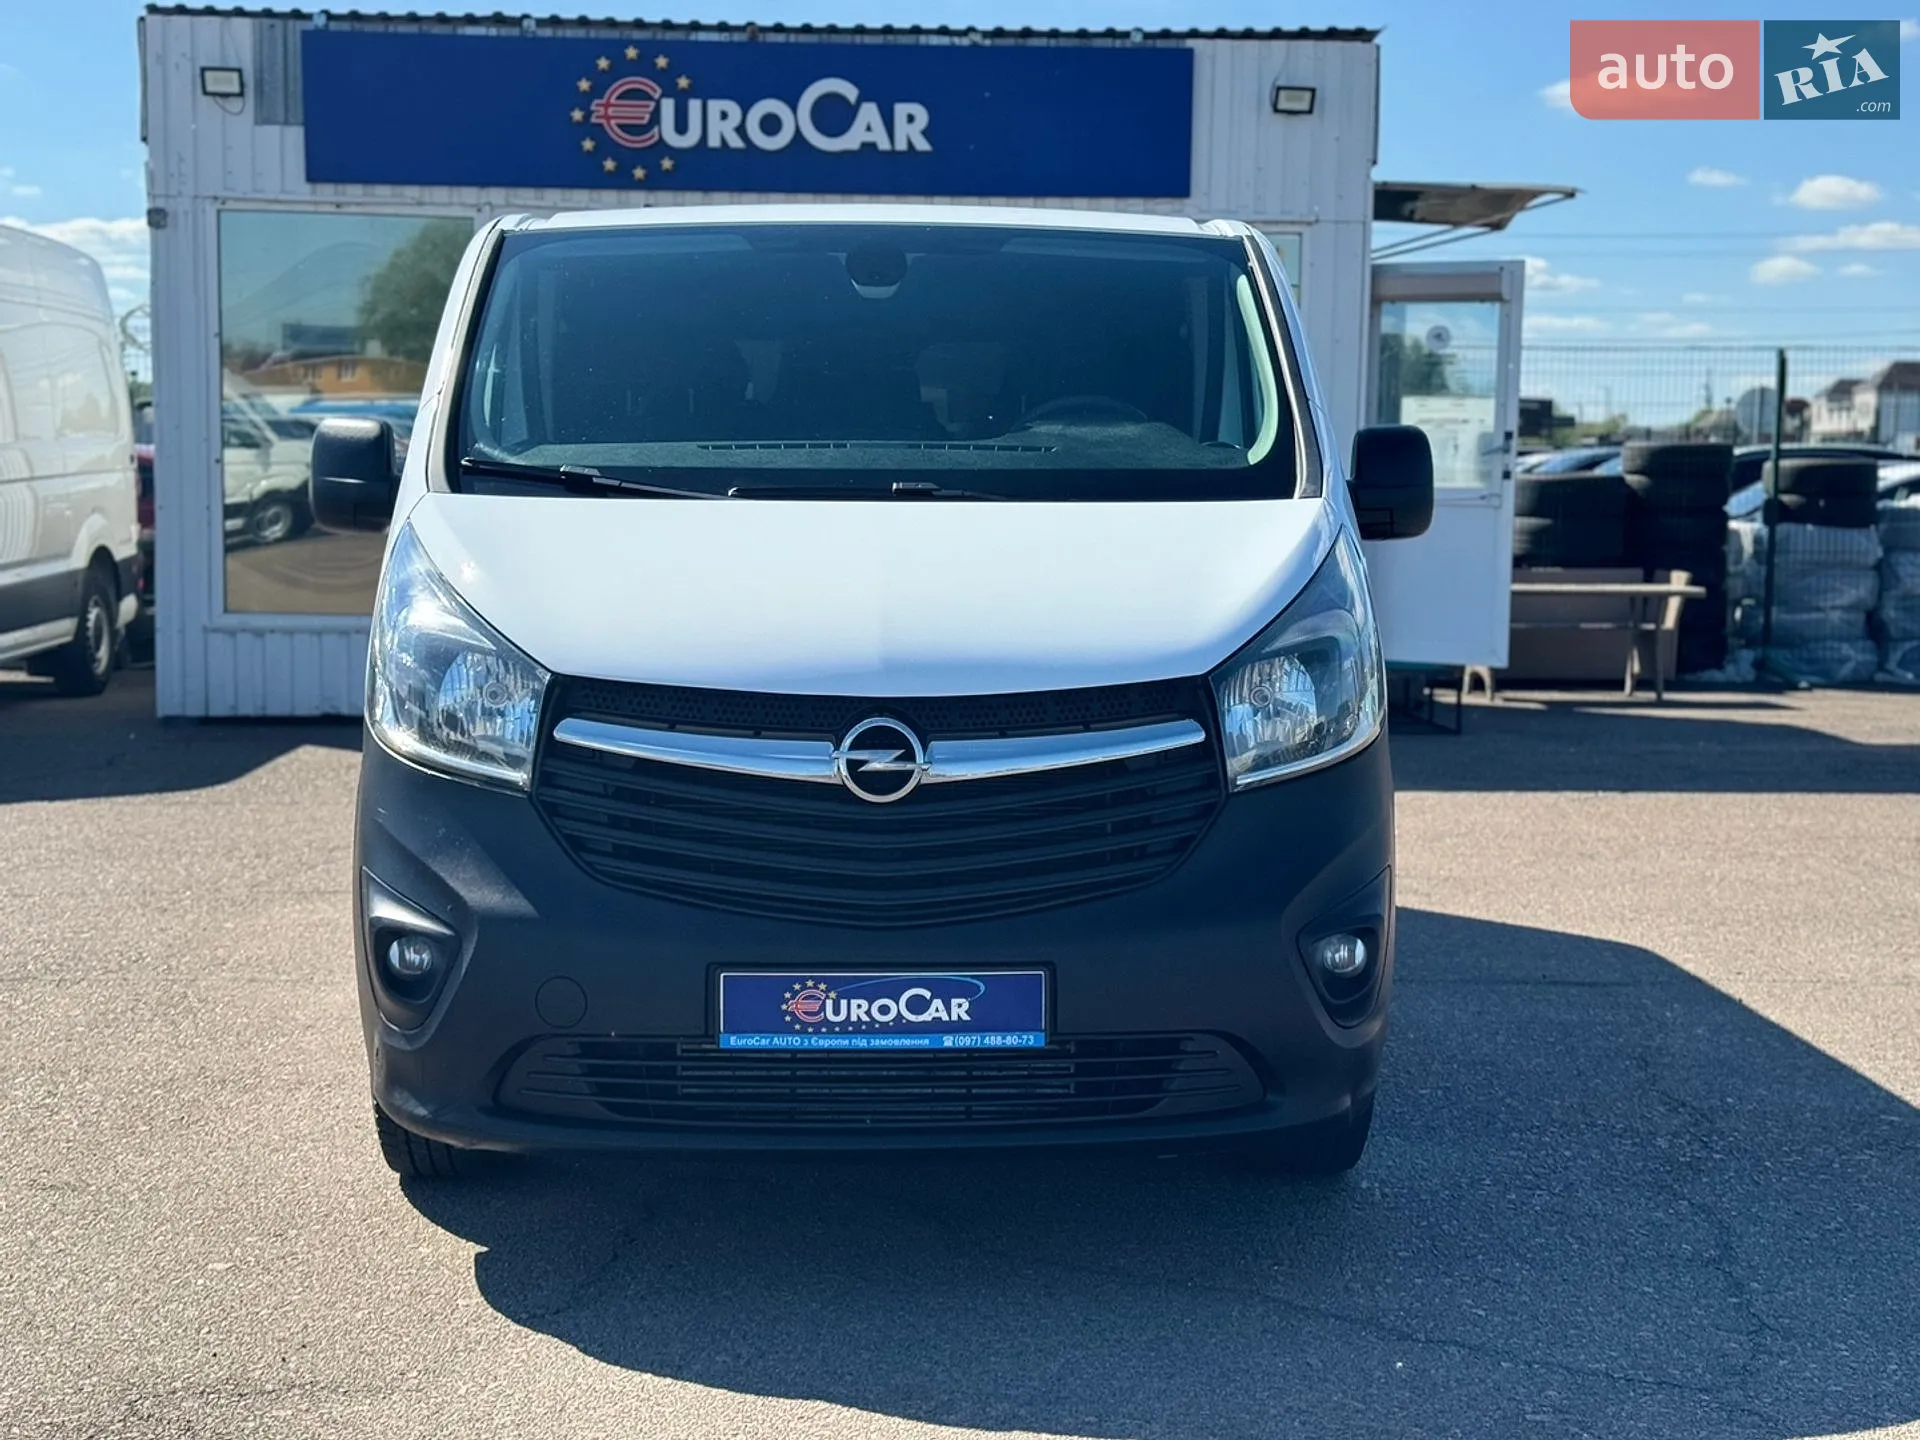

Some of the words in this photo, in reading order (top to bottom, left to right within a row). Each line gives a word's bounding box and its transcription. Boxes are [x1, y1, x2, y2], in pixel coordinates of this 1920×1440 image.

[730, 1036, 770, 1046] EuroCar
[772, 1036, 801, 1046] AUTO
[870, 1037, 930, 1046] замовлення
[954, 1034, 980, 1046] (097)
[983, 1034, 1034, 1046] 488-80-73
